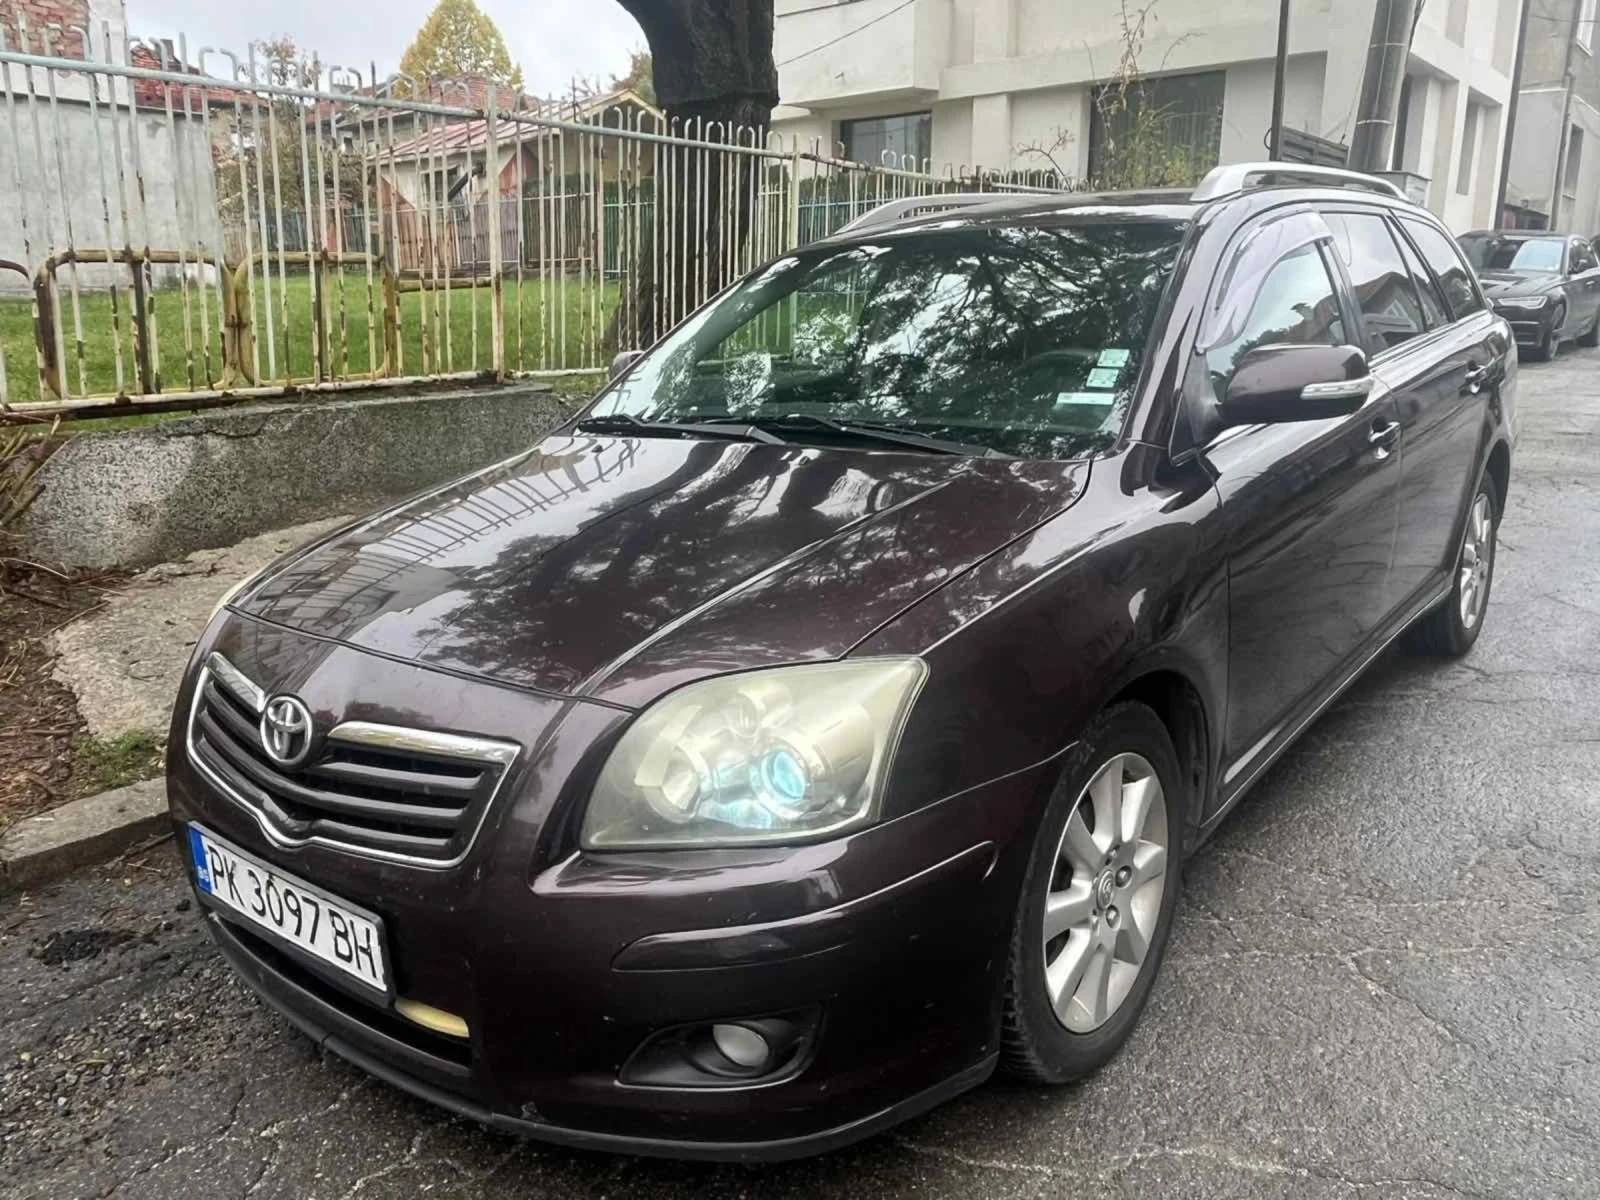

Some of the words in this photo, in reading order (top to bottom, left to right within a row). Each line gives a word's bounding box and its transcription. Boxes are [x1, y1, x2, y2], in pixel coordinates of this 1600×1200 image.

[208, 845, 245, 908] PK
[248, 869, 320, 944] 3097
[328, 908, 377, 979] BH
